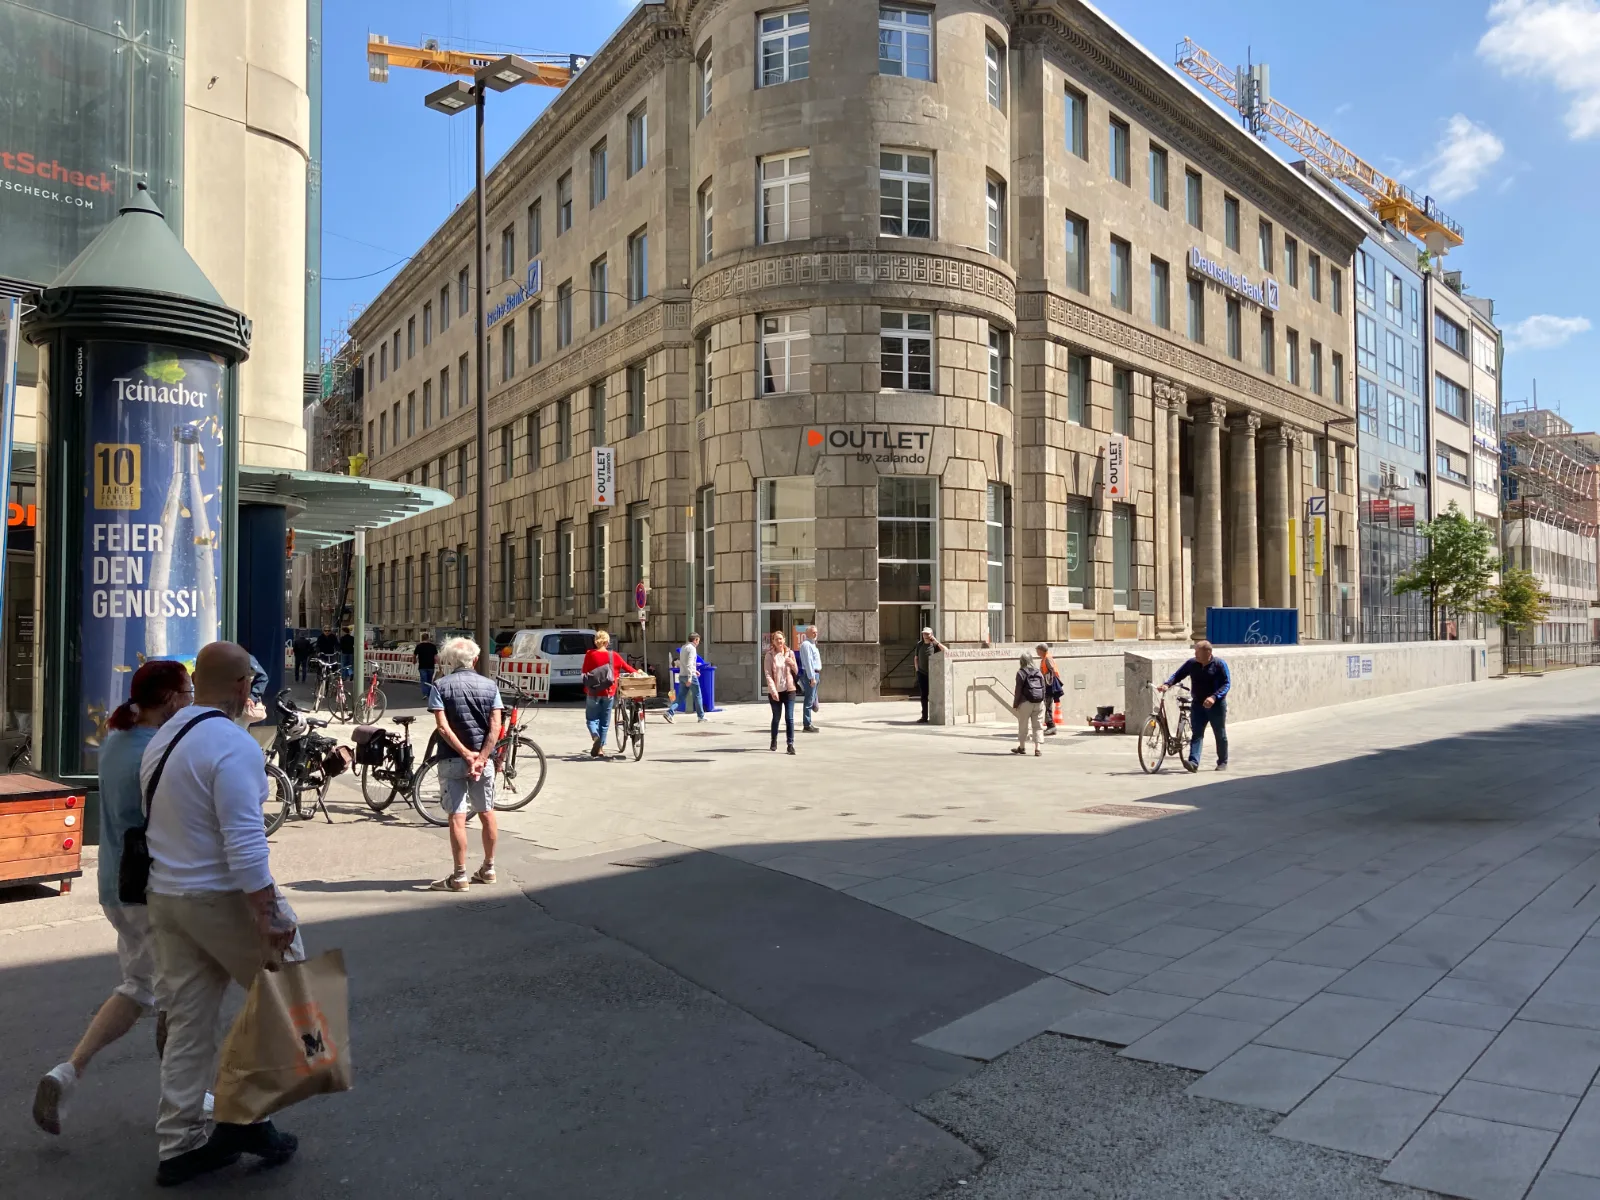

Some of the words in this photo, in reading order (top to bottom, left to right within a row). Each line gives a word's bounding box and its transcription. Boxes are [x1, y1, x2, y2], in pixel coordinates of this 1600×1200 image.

[0, 151, 115, 194] tScheck
[1192, 246, 1239, 290] Deutsche
[1241, 274, 1264, 303] Bank
[75, 347, 83, 397] JCDecaux
[112, 378, 207, 408] Teinacher
[829, 430, 930, 449] OUTLET
[98, 448, 134, 486] 10
[597, 451, 606, 493] OUTLET
[856, 452, 872, 464] by
[876, 453, 925, 464] zalando
[1109, 442, 1119, 484] OUTLET
[101, 486, 134, 494] JAHRE
[93, 523, 164, 551] FEIER
[93, 557, 143, 584] DEN
[93, 590, 197, 618] GENUSS!
